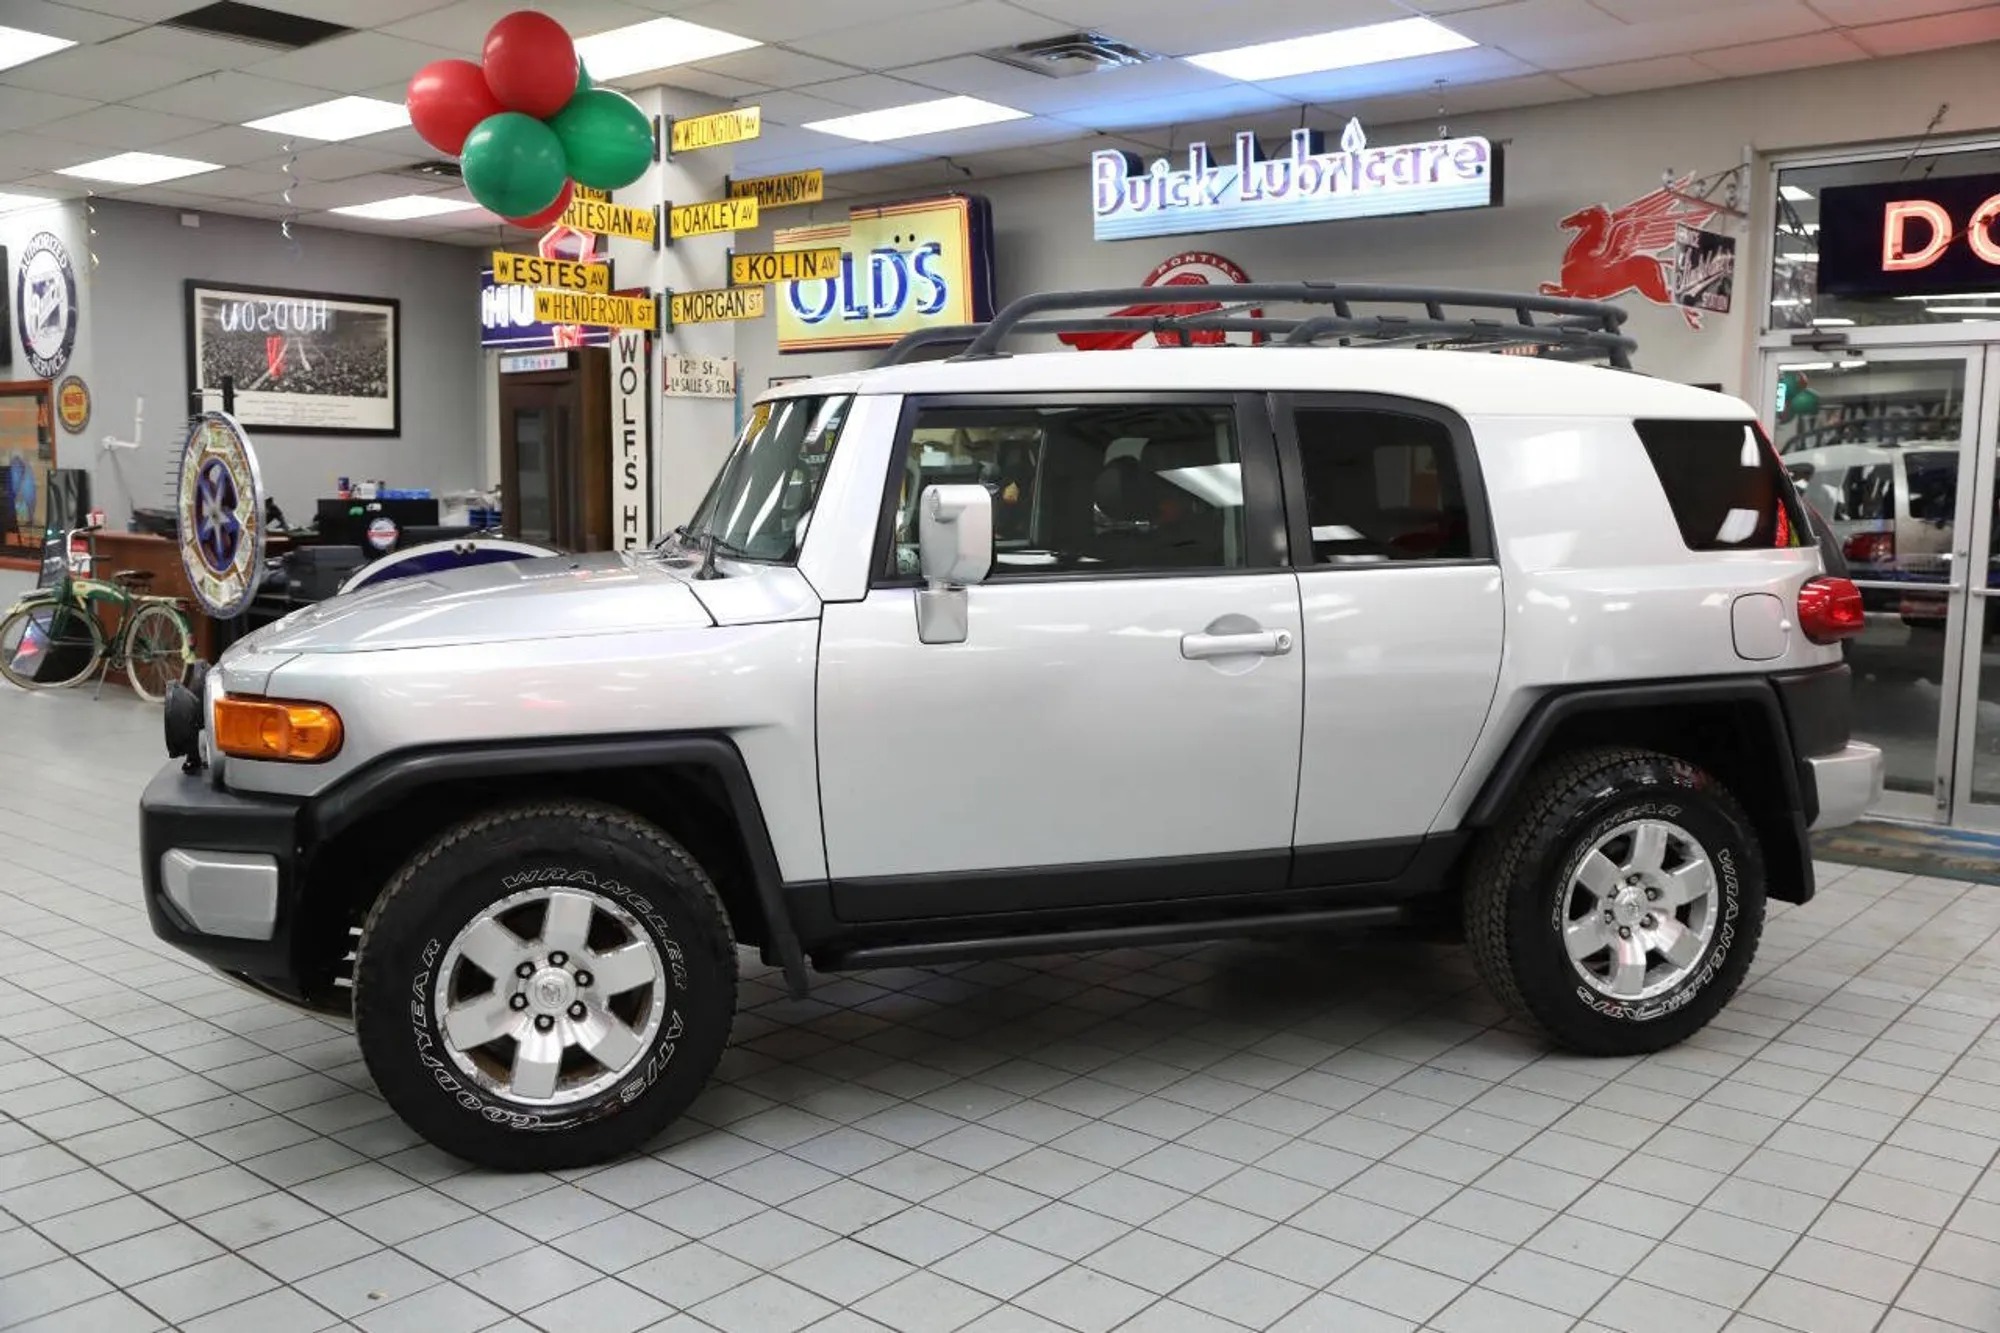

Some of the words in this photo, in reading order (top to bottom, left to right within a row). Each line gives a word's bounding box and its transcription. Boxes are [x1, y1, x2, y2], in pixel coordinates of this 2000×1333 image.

[684, 114, 743, 147] WELLINGTON
[745, 116, 756, 131] AV
[1095, 146, 1219, 215] Buick
[1237, 119, 1488, 203] Lubricare
[741, 175, 808, 205] NORMANDY
[808, 175, 820, 193] AV
[636, 217, 650, 233] AV
[673, 215, 680, 230] N
[682, 202, 739, 233] OAKLEY
[742, 205, 753, 221] AV
[498, 259, 508, 277] W
[513, 257, 588, 290] ESTES
[591, 271, 606, 288] AV
[735, 261, 744, 278] S
[748, 252, 818, 281] KOLIN
[822, 257, 836, 272] AV
[1157, 254, 1242, 283] PONTIAC
[538, 297, 549, 315] W
[553, 292, 634, 326] HENDERSON
[637, 305, 653, 322] ST
[673, 301, 681, 318] S
[682, 290, 746, 323] MORGAN
[748, 293, 761, 311] ST
[618, 334, 638, 491] WOLF'S
[502, 866, 688, 991] WRANGLER
[410, 937, 541, 1129] GOODYEAR
